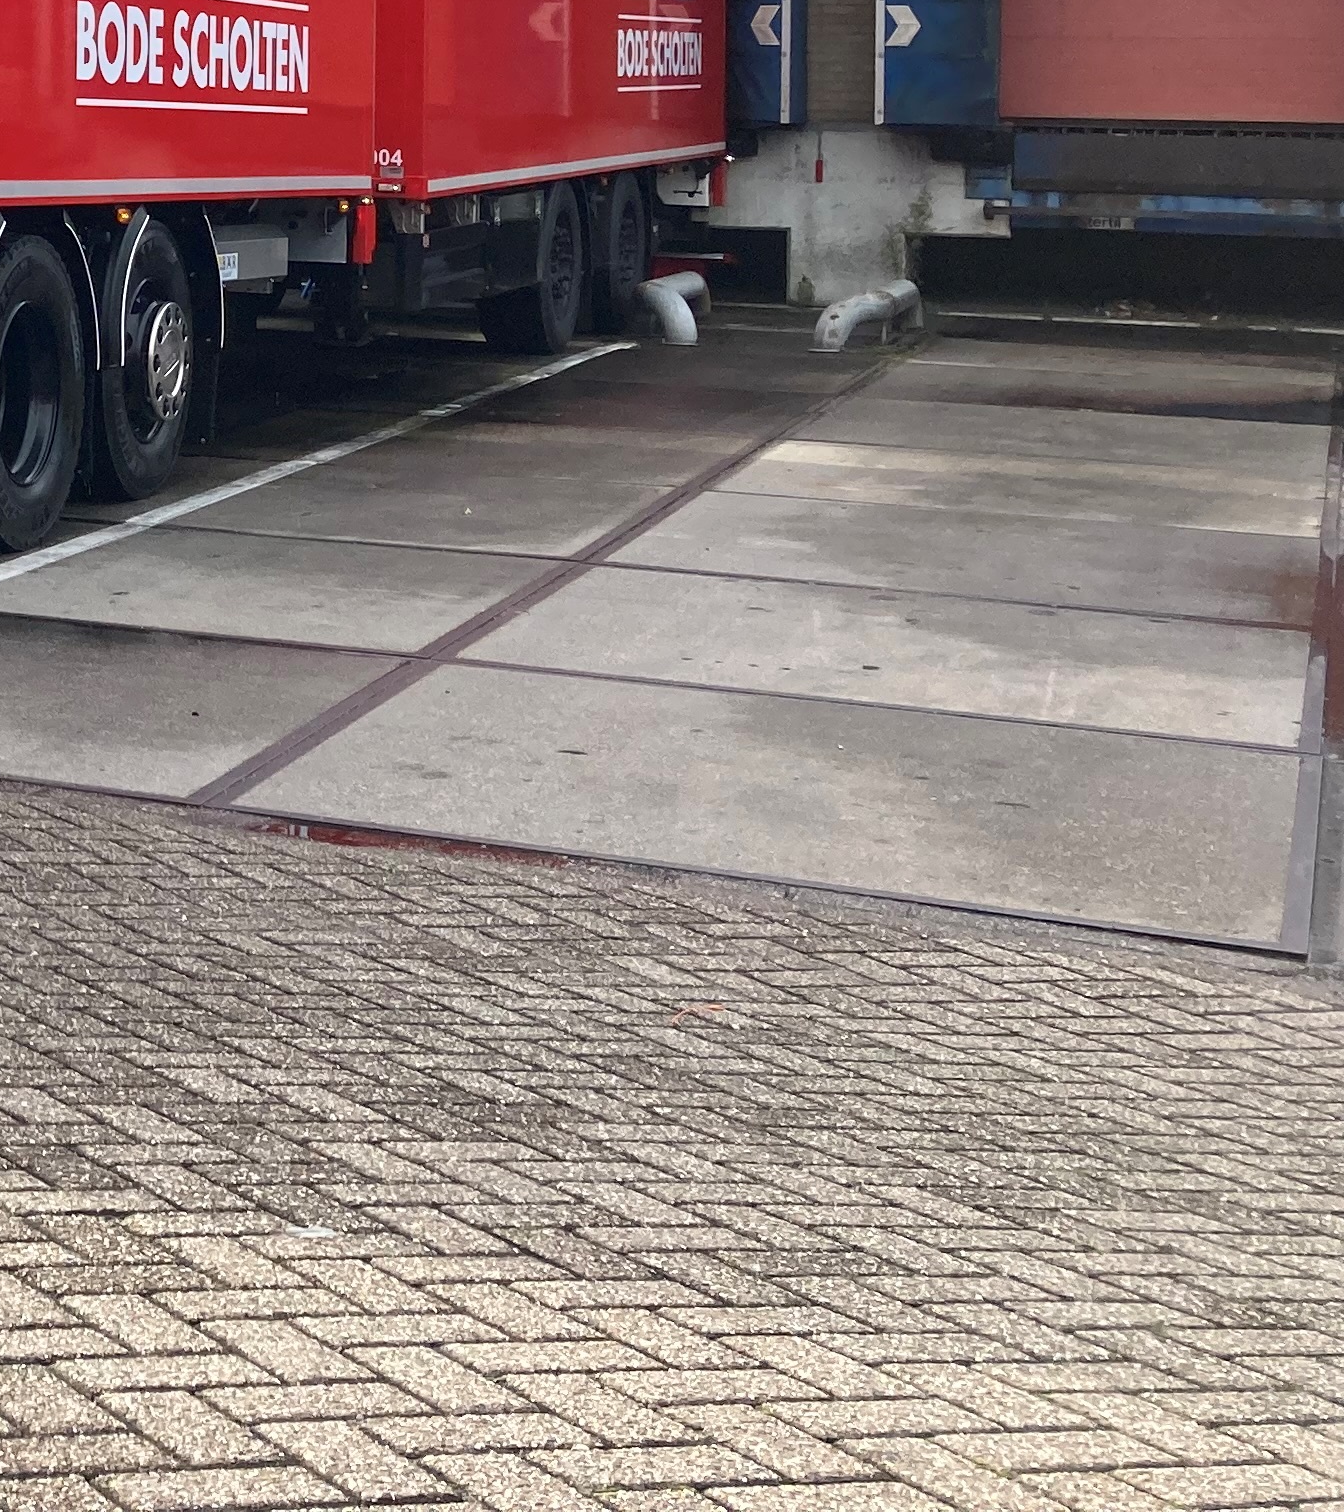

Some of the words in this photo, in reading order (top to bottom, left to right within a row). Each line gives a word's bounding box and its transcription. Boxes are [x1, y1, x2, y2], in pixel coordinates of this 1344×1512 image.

[76, 0, 165, 85] BODE
[172, 9, 309, 93] SCHOLTEN
[617, 28, 649, 78] BODE
[651, 29, 702, 77] SCHOLTEN
